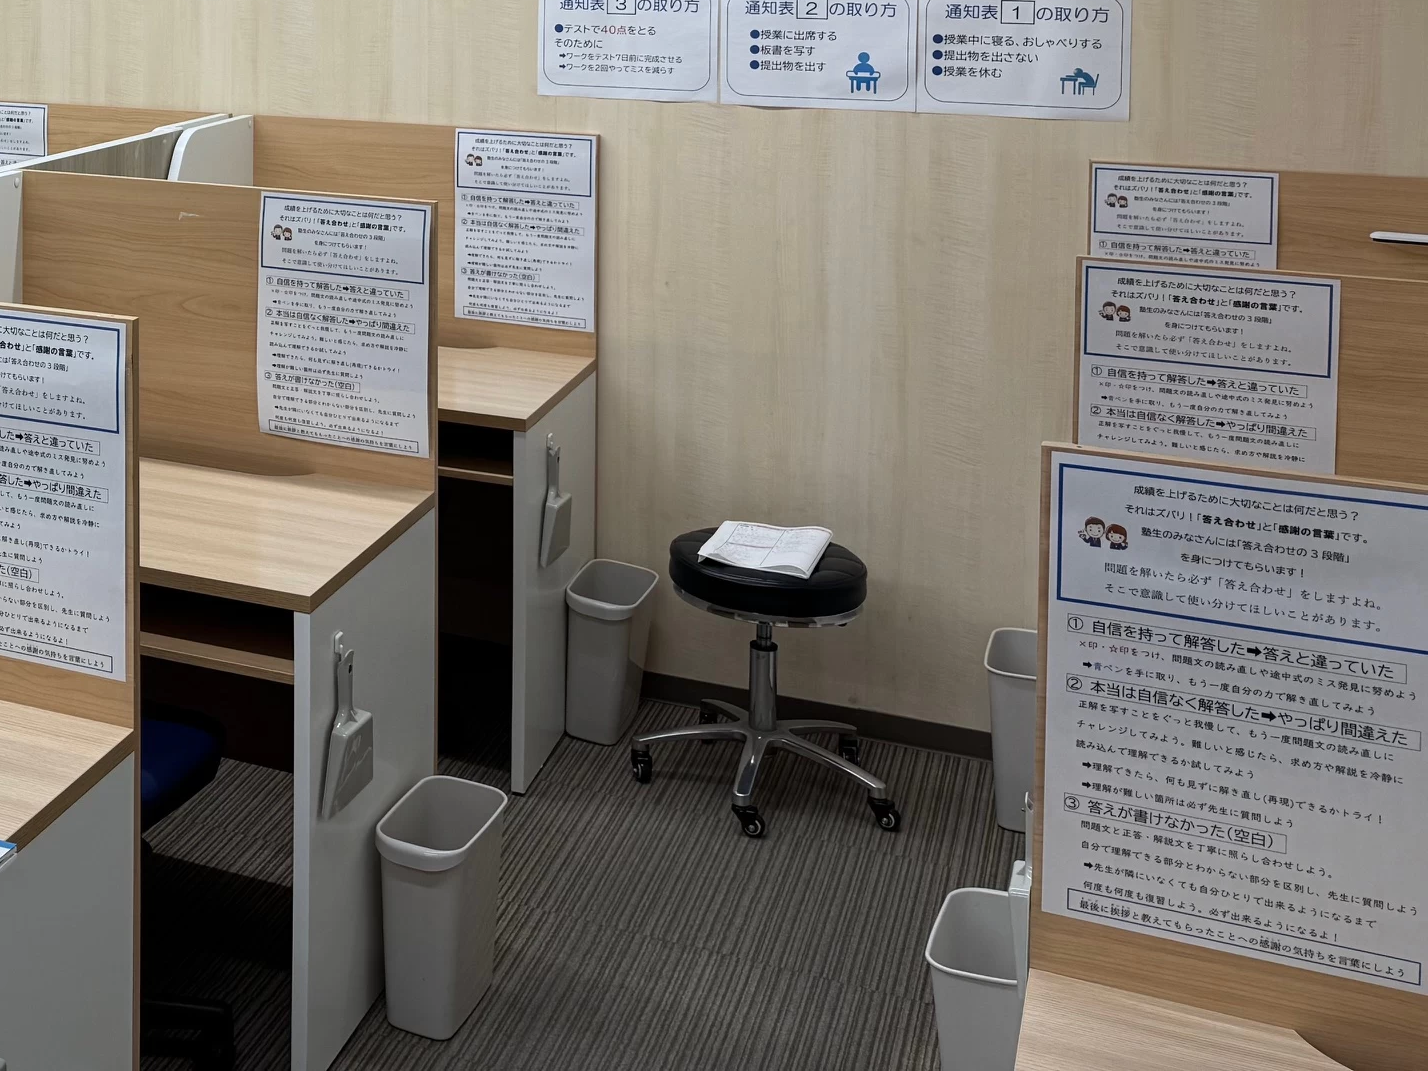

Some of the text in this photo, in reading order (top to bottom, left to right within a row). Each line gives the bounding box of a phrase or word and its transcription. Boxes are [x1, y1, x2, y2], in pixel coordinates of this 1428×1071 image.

[564, 25, 656, 35] テストで40点をとる
[761, 30, 837, 41] 授業に出席する
[555, 38, 603, 48] そのために
[944, 34, 1102, 49] 授業中に寝る、おしゃべりする
[761, 45, 815, 56] 板書を写す
[944, 50, 1038, 63] 提出物を出さない
[567, 63, 674, 74] ワークを2回やってミスを減らす
[760, 60, 826, 72] 提出物を出す
[943, 66, 1002, 78] 授業を休む
[24, 433, 93, 452] 答えと違っていた
[1134, 485, 1359, 521] 成績を上げるために大切なことは何だと思う？
[1180, 552, 1305, 577] を身につけてもらいます！
[1093, 620, 1246, 656] 自信を持って解答した
[1263, 646, 1394, 679] 答えと違っていた
[1091, 681, 1260, 720] 本当は自信なく解答した
[1278, 712, 1407, 746] やっぱり間違えた
